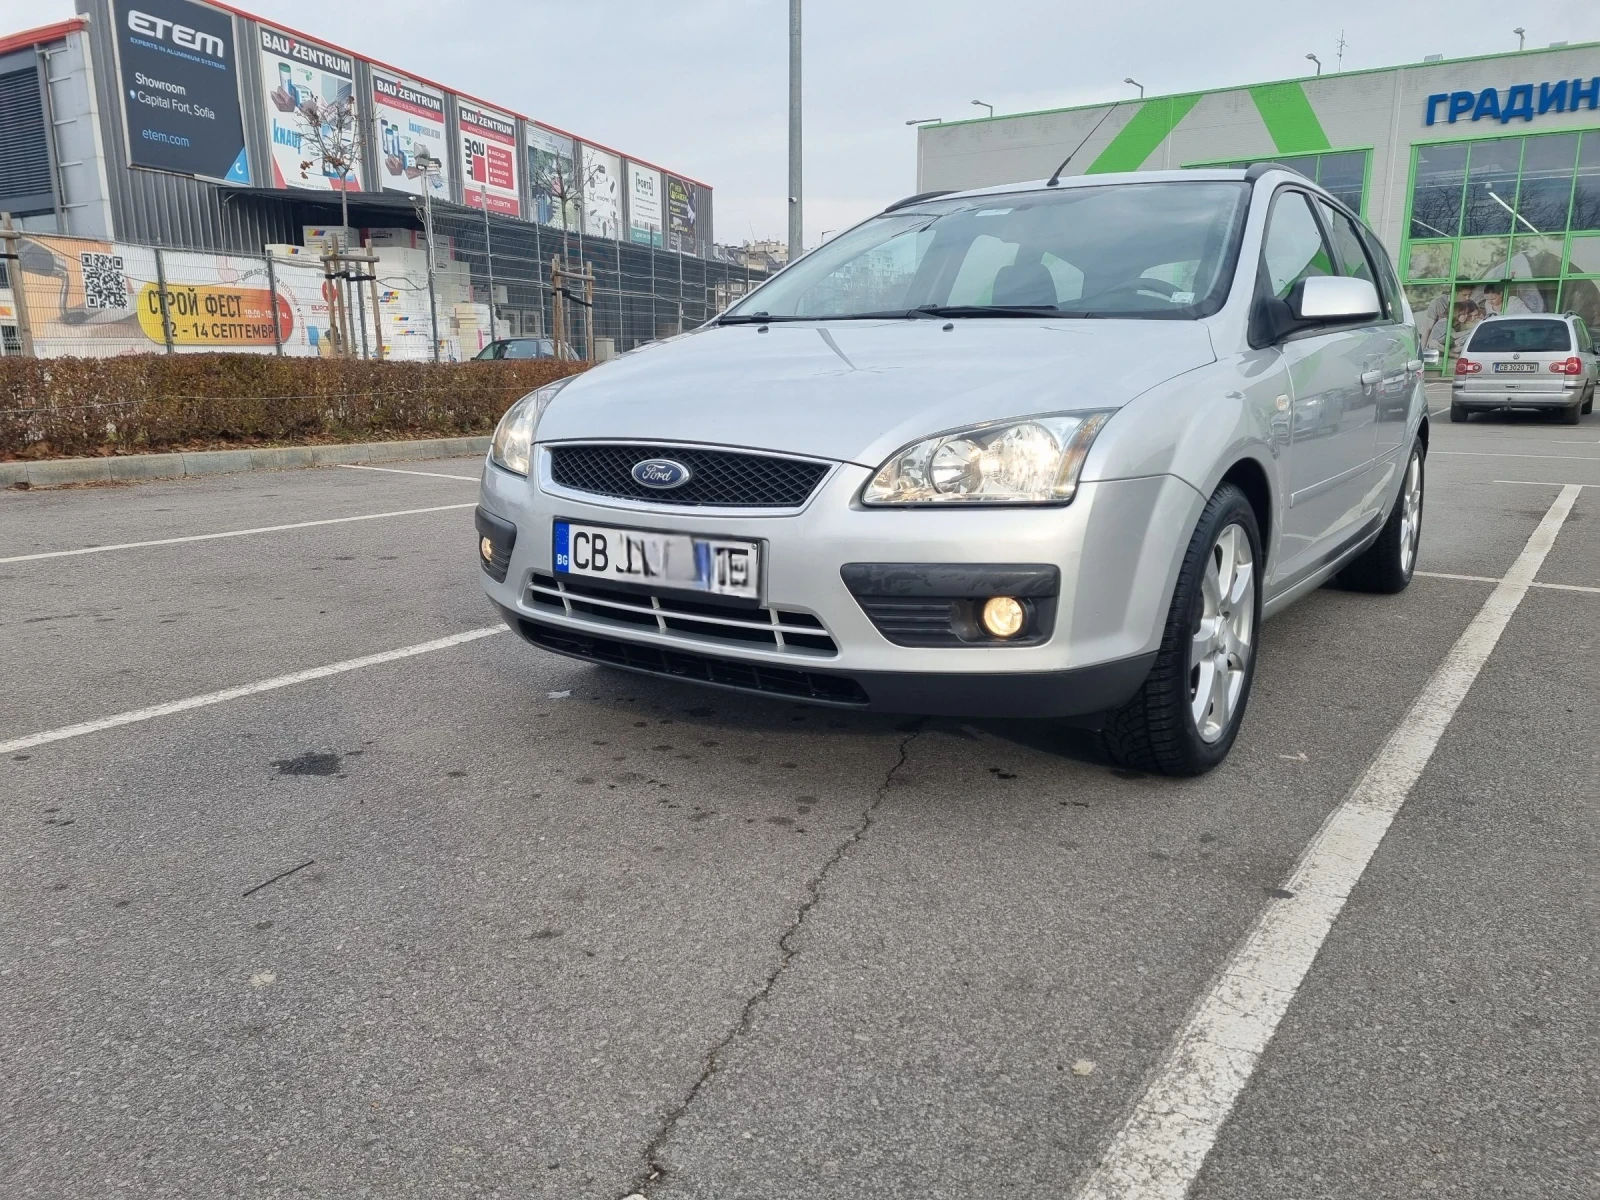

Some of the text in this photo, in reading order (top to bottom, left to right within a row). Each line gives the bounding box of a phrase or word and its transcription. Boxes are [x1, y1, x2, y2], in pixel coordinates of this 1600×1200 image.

[128, 9, 224, 58] ETEM
[130, 37, 158, 50] EXPERTS
[166, 48, 200, 63] ALUMINIUM
[200, 58, 226, 70] SYSTEMS
[261, 31, 351, 74] BAU ZENTRUM
[135, 72, 186, 96] Showroom
[376, 80, 441, 110] BAU ZENTRUM
[137, 90, 215, 120] Capital Fort, Sofia
[1425, 76, 1600, 126] ГРАДИН
[461, 110, 513, 135] BAU ZENTRUM
[142, 129, 190, 147] etem.com
[205, 293, 242, 318] ФЕСТ
[193, 322, 208, 338] 14
[1509, 363, 1525, 371] 3020
[642, 465, 672, 481] Ford
[557, 553, 569, 566] BG
